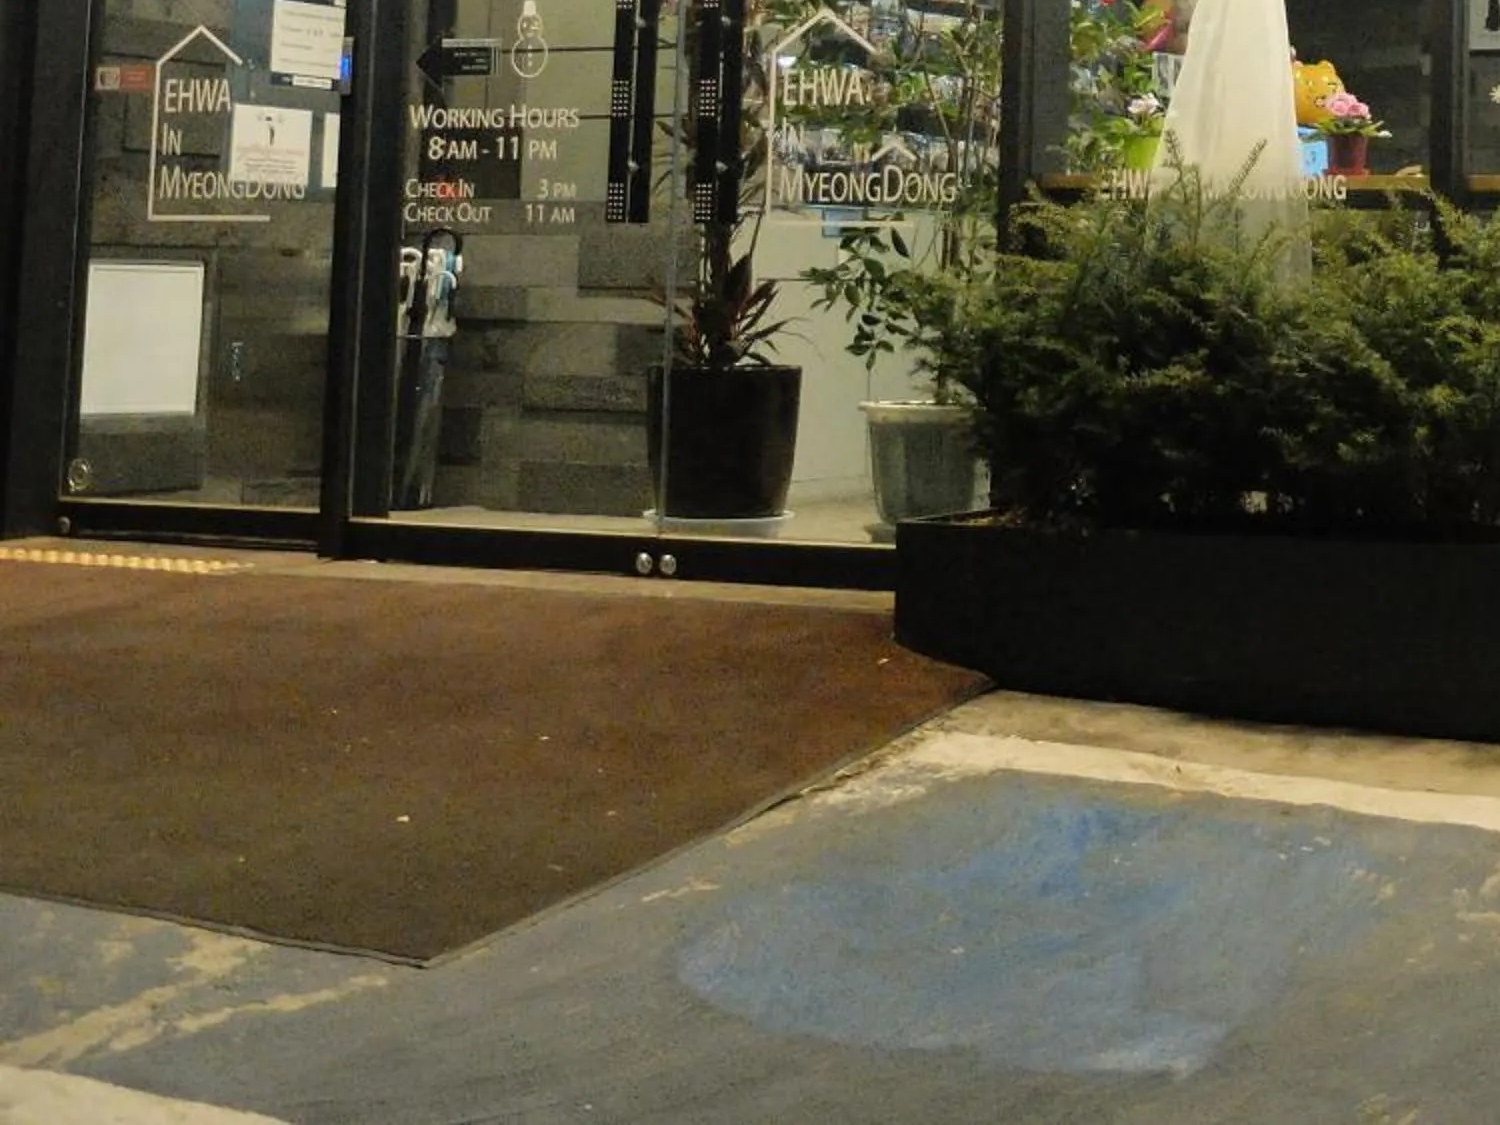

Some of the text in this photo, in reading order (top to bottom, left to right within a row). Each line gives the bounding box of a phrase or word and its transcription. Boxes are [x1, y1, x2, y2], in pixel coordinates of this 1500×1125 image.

[164, 78, 232, 113] EHWA
[782, 68, 866, 106] EHWA
[409, 105, 580, 129] WORKING HOURS
[162, 123, 182, 156] IN
[495, 136, 520, 160] 11
[529, 140, 558, 160] PM
[404, 178, 577, 199] CHECK IN 3 PM
[779, 165, 958, 204] MYEONGDONG
[404, 202, 454, 223] CHECK
[456, 202, 493, 223] OUT
[550, 207, 576, 223] AM
